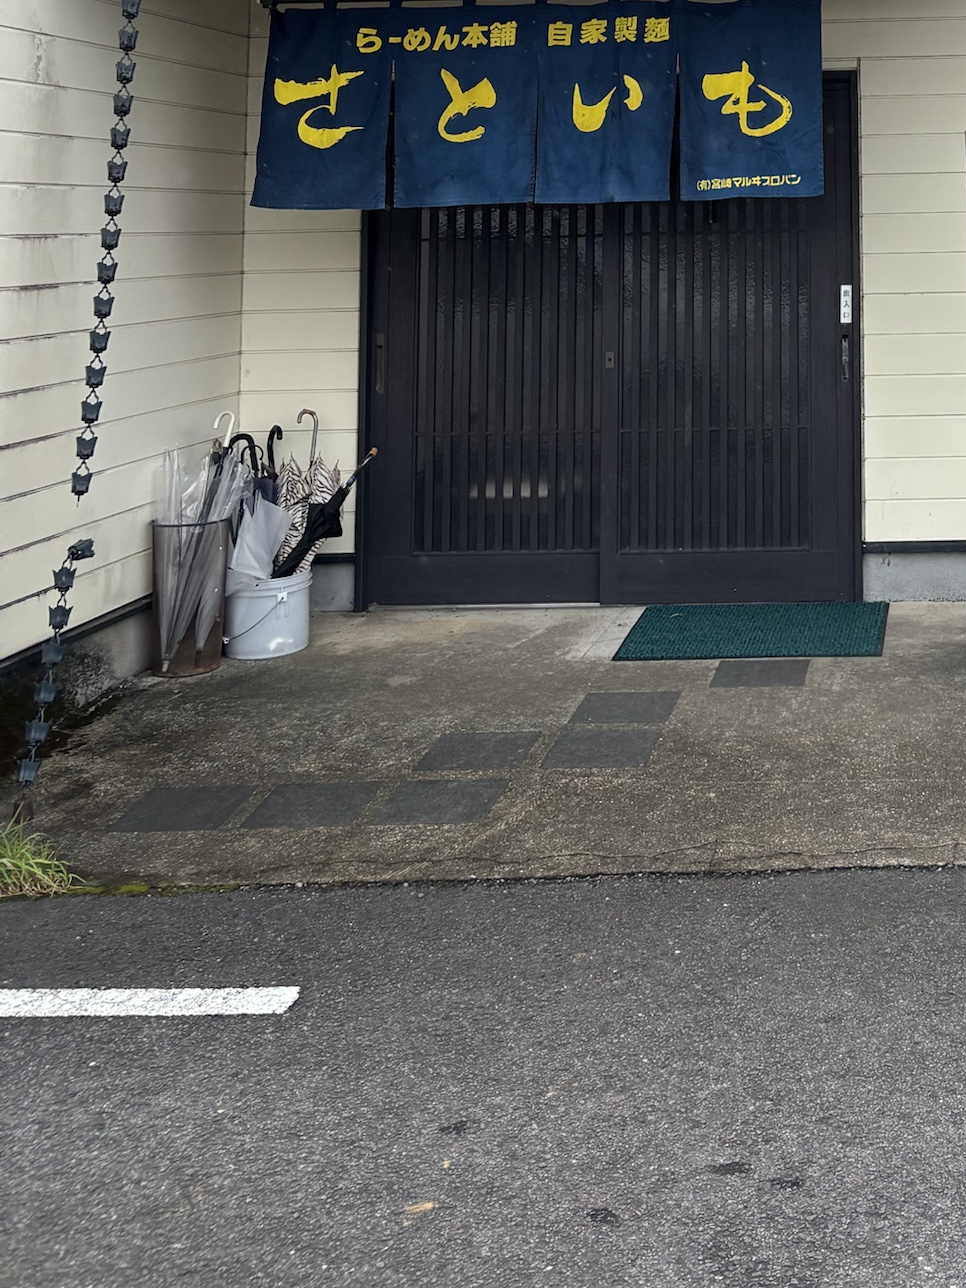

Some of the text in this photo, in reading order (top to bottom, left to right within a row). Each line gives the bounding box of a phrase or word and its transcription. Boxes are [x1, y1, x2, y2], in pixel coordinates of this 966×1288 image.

[356, 21, 518, 53] らーめん本舗
[274, 61, 792, 150] さといも
